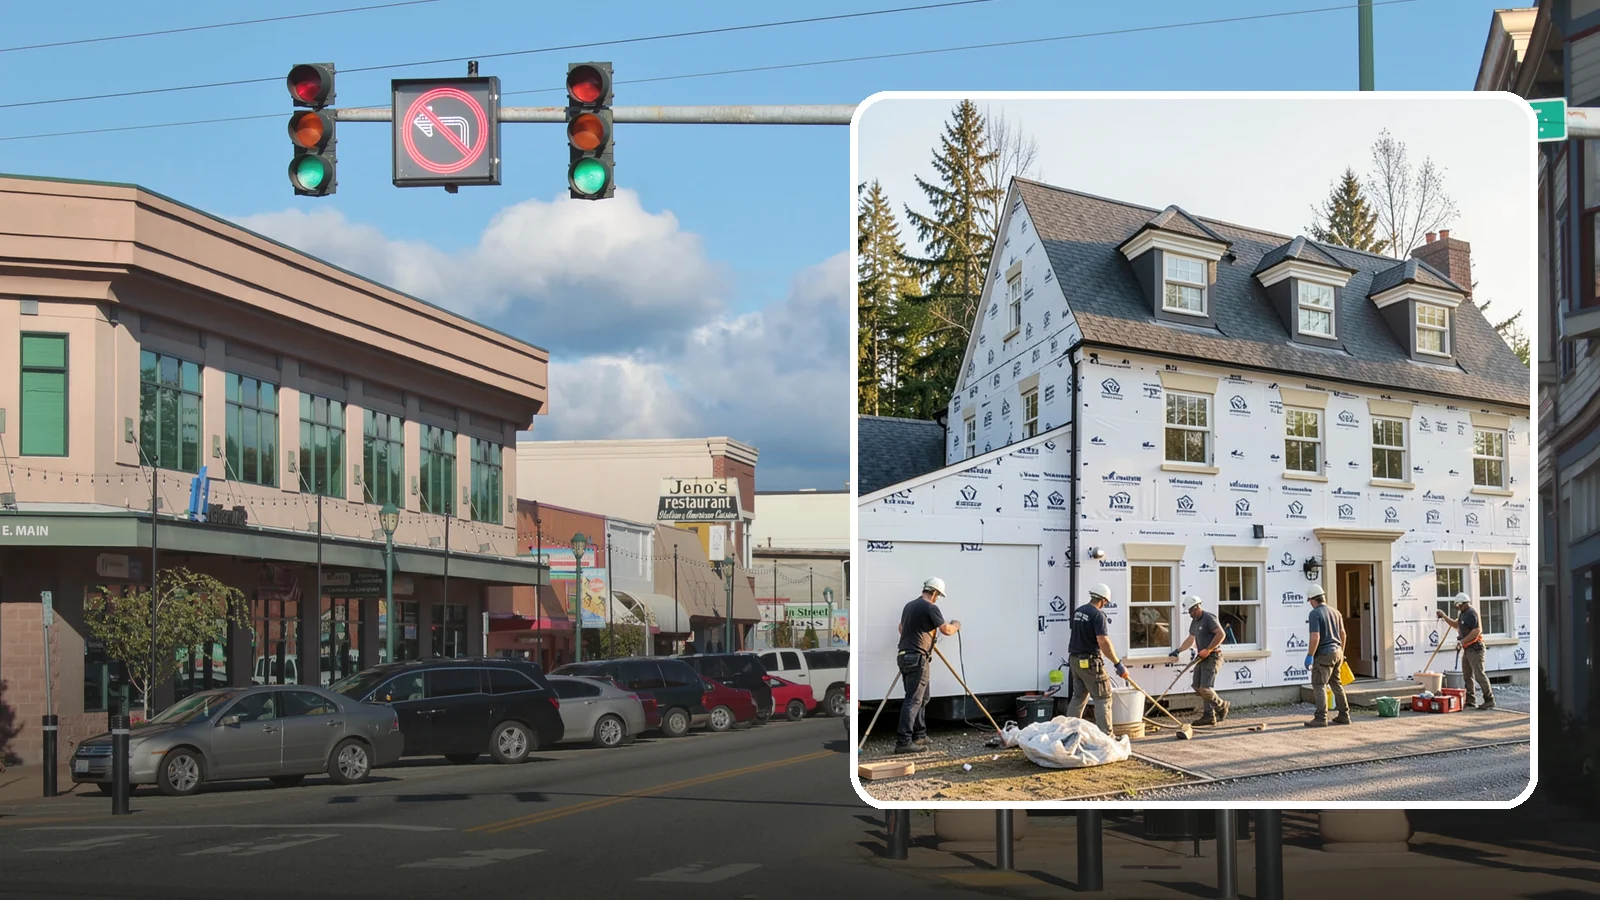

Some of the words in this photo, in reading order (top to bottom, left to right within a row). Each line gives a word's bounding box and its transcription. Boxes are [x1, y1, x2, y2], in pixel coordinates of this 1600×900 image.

[669, 480, 728, 495] Jeno's
[665, 496, 731, 509] restaurant
[659, 510, 681, 519] Italian
[686, 509, 714, 519] American
[715, 509, 737, 519] Cuisine
[2, 525, 13, 536] E.
[15, 525, 49, 536] MAIN
[797, 607, 828, 616] Street
